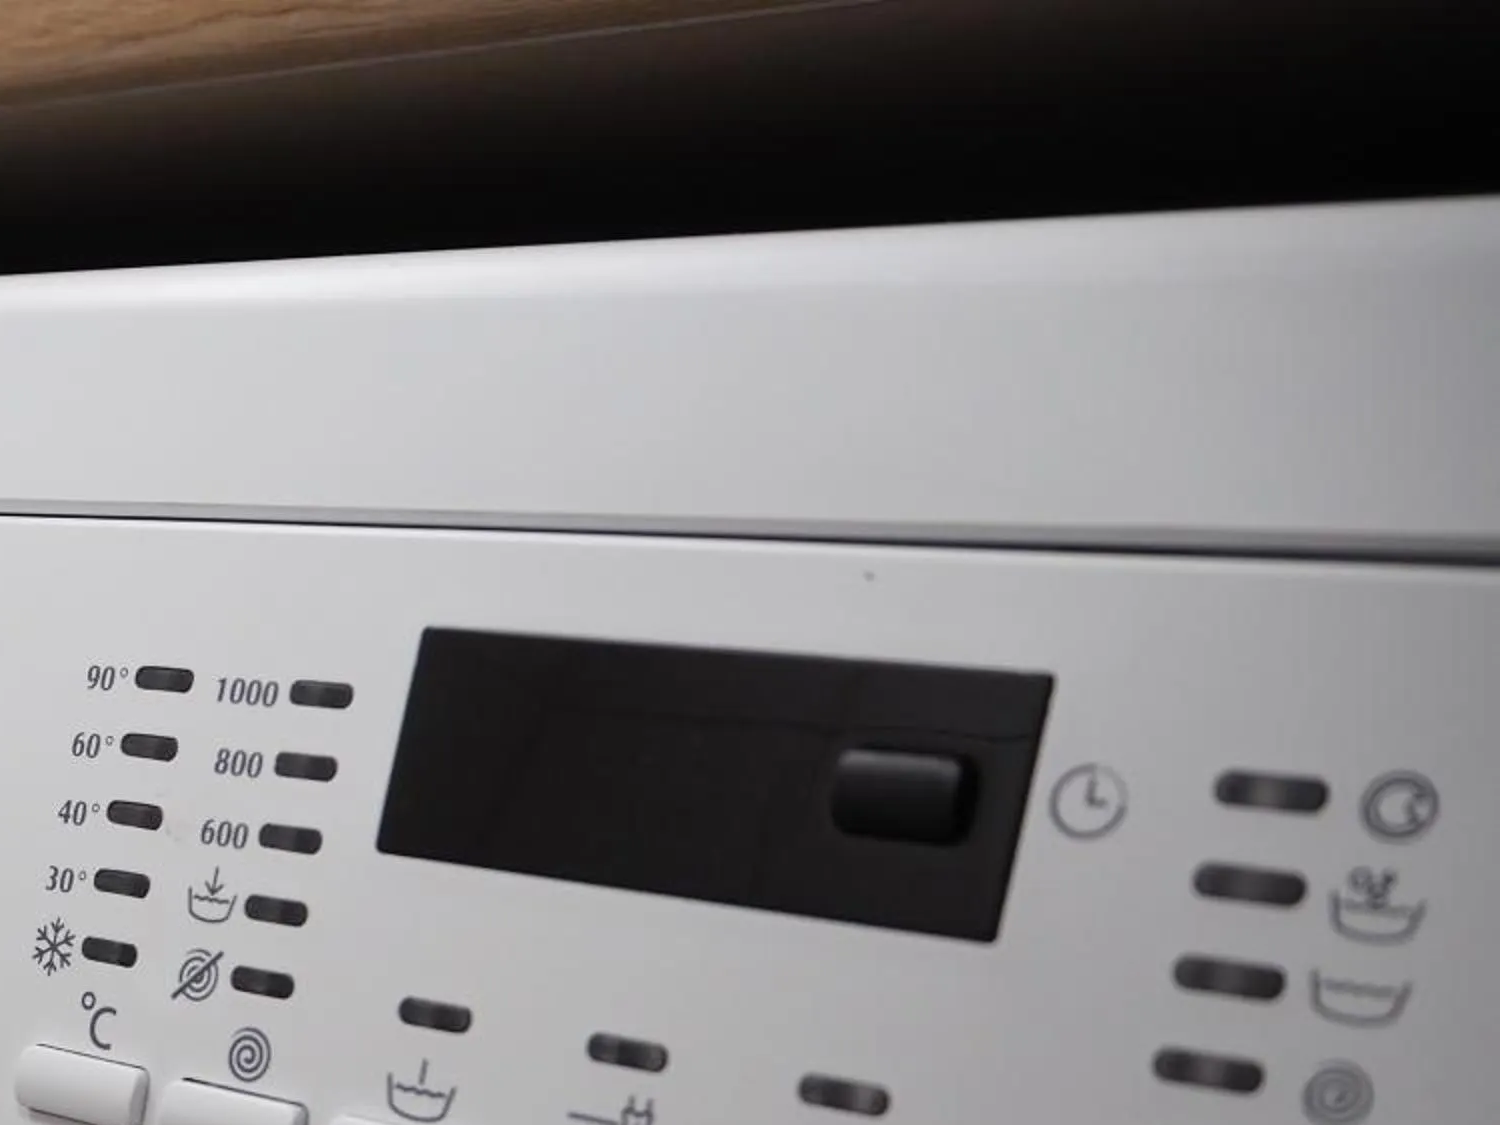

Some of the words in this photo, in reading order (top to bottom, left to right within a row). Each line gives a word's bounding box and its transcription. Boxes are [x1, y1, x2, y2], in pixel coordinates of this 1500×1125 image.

[86, 665, 129, 691] 90°
[215, 677, 279, 707] 1000
[71, 732, 114, 759] 60°
[214, 748, 264, 778] 800
[57, 800, 100, 826] 40°
[200, 819, 249, 850] 600
[45, 865, 87, 893] 30°
